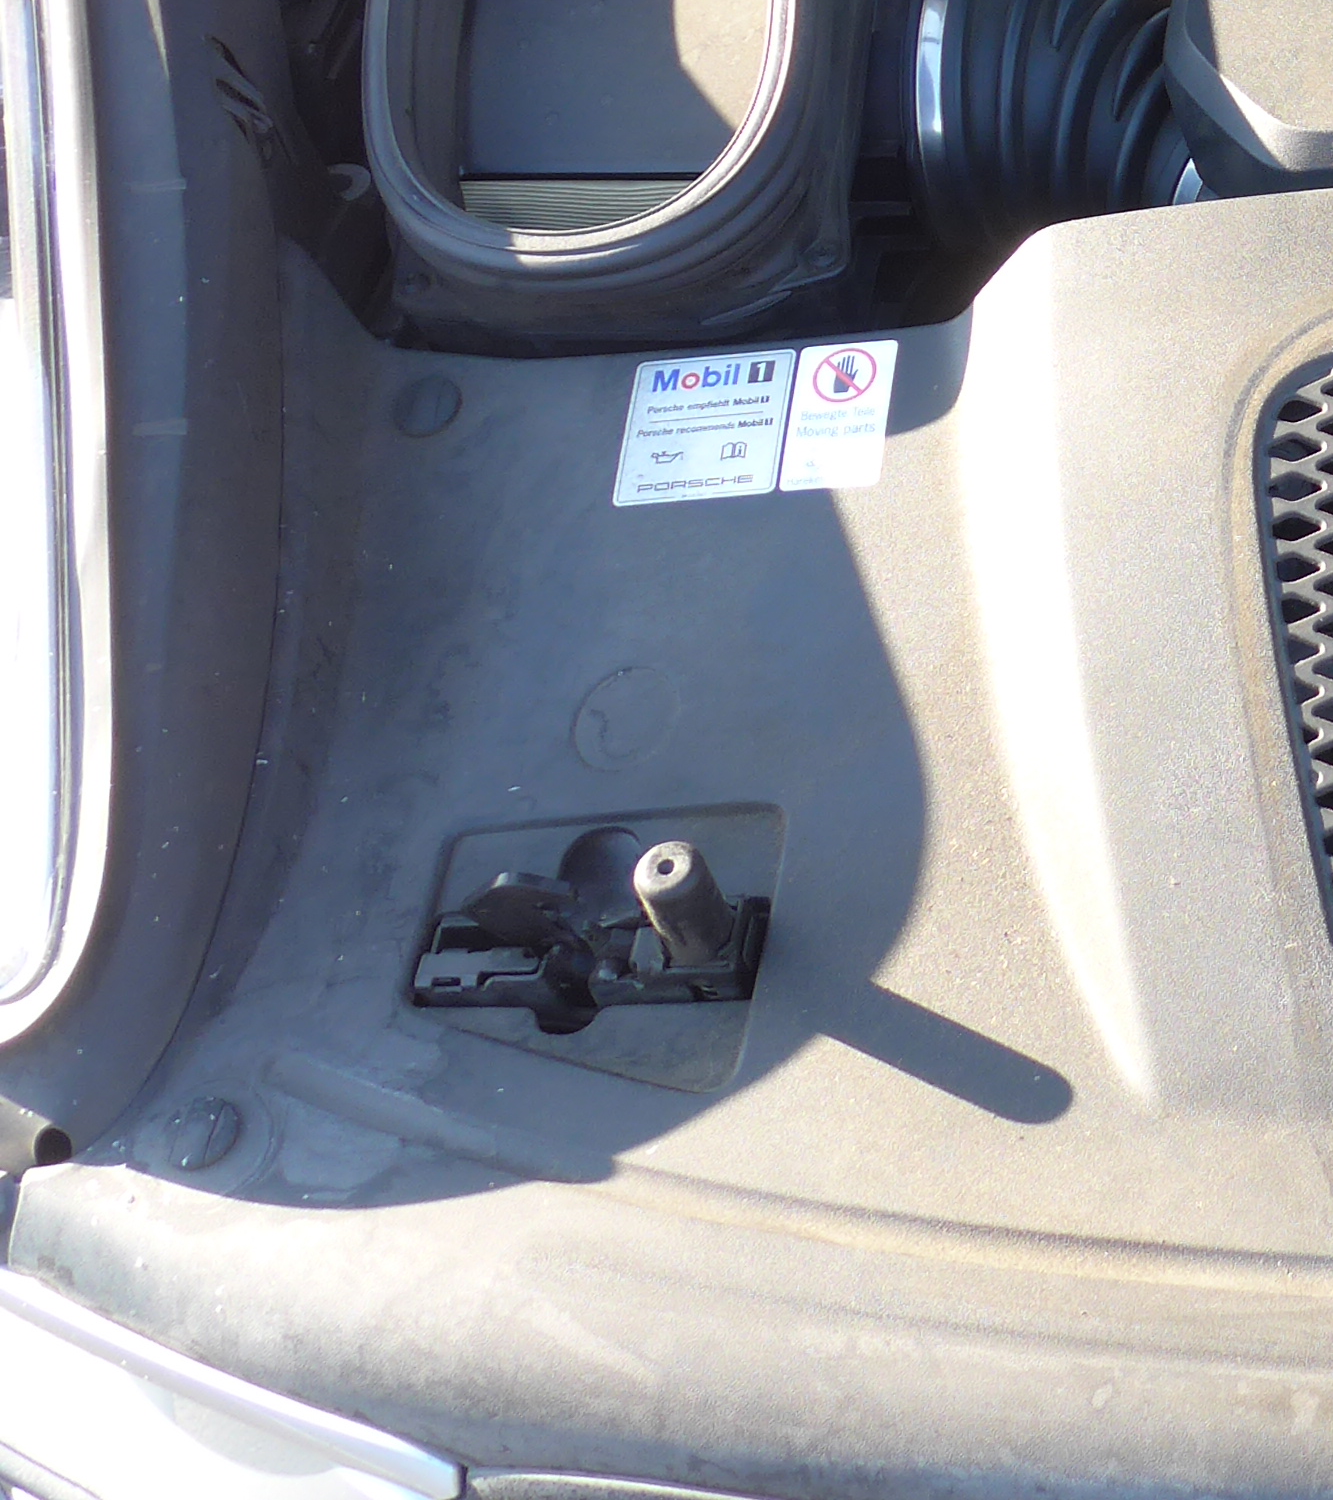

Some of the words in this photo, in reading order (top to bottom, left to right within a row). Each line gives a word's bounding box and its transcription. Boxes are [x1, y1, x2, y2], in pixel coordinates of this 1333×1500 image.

[652, 363, 741, 393] Mobil
[752, 361, 771, 383] 1
[647, 403, 684, 414] Porsche
[733, 396, 760, 406] Mobil
[801, 410, 847, 421] Bewegte
[636, 428, 673, 438] Porsche
[738, 418, 763, 428] Mobil
[796, 426, 838, 437] Moving
[844, 423, 875, 435] parts
[637, 474, 754, 493] PORSCHE
